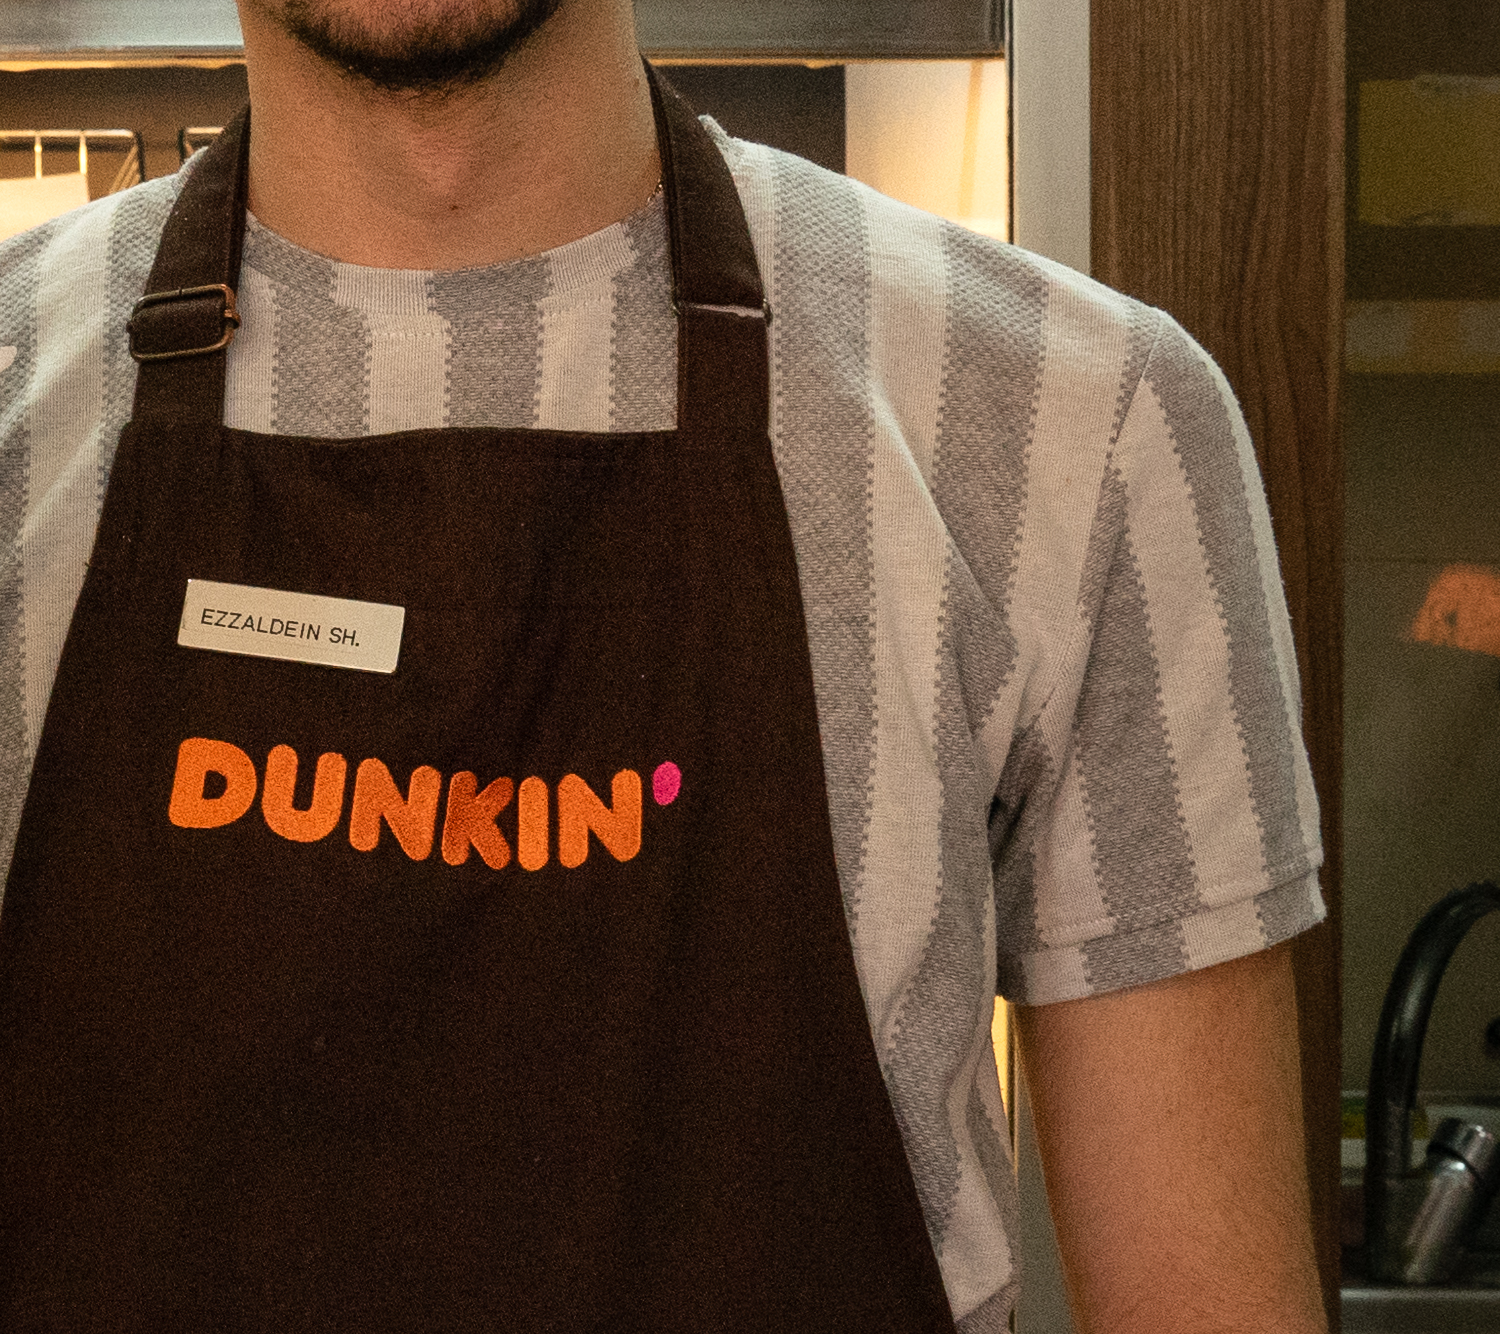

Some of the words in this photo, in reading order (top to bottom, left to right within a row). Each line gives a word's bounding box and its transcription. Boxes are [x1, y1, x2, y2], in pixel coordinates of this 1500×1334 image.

[200, 607, 321, 643] EZZALDEIN
[328, 625, 361, 648] SH.
[168, 736, 682, 871] DUNKIN'
